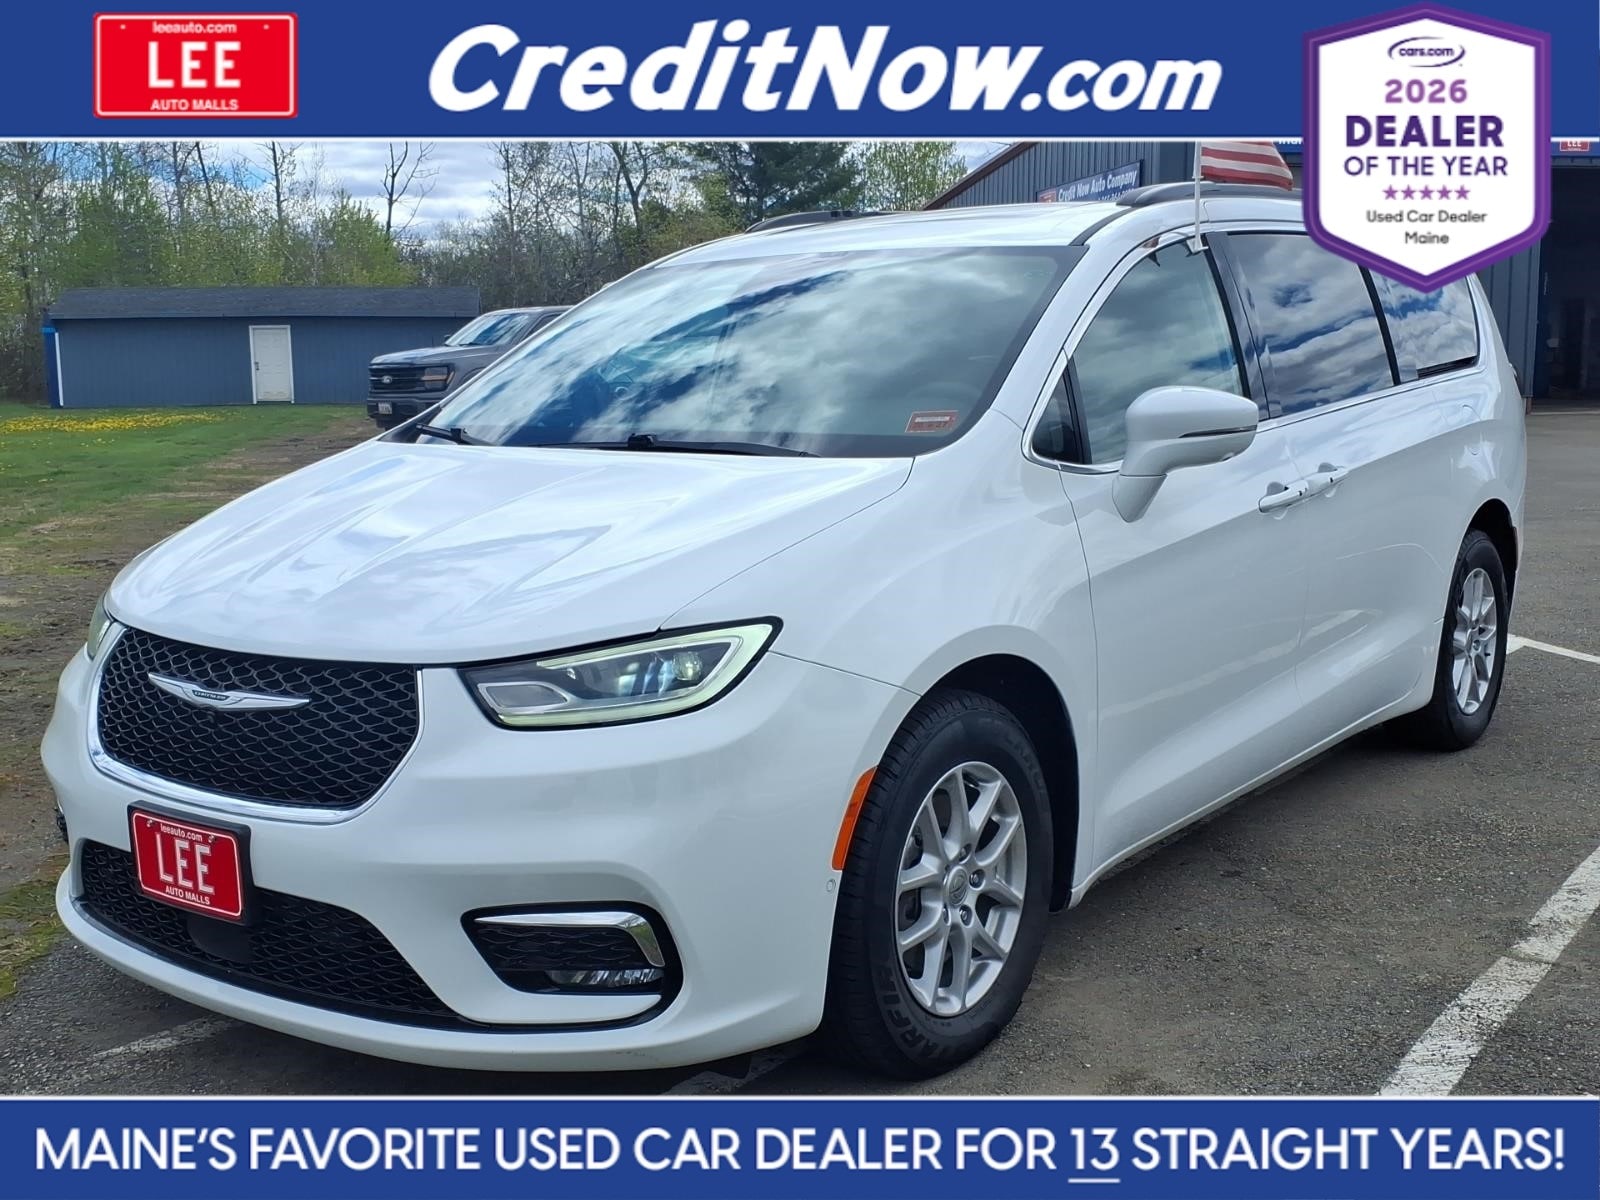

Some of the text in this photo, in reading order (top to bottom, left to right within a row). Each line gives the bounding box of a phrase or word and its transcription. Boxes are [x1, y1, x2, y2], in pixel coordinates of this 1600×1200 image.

[1076, 182, 1090, 197] Now
[1090, 177, 1106, 193] Auto
[1106, 170, 1138, 189] Company
[160, 823, 203, 842] leeauto.com
[155, 831, 215, 895] LEE
[165, 885, 211, 905] AUTO MALLS
